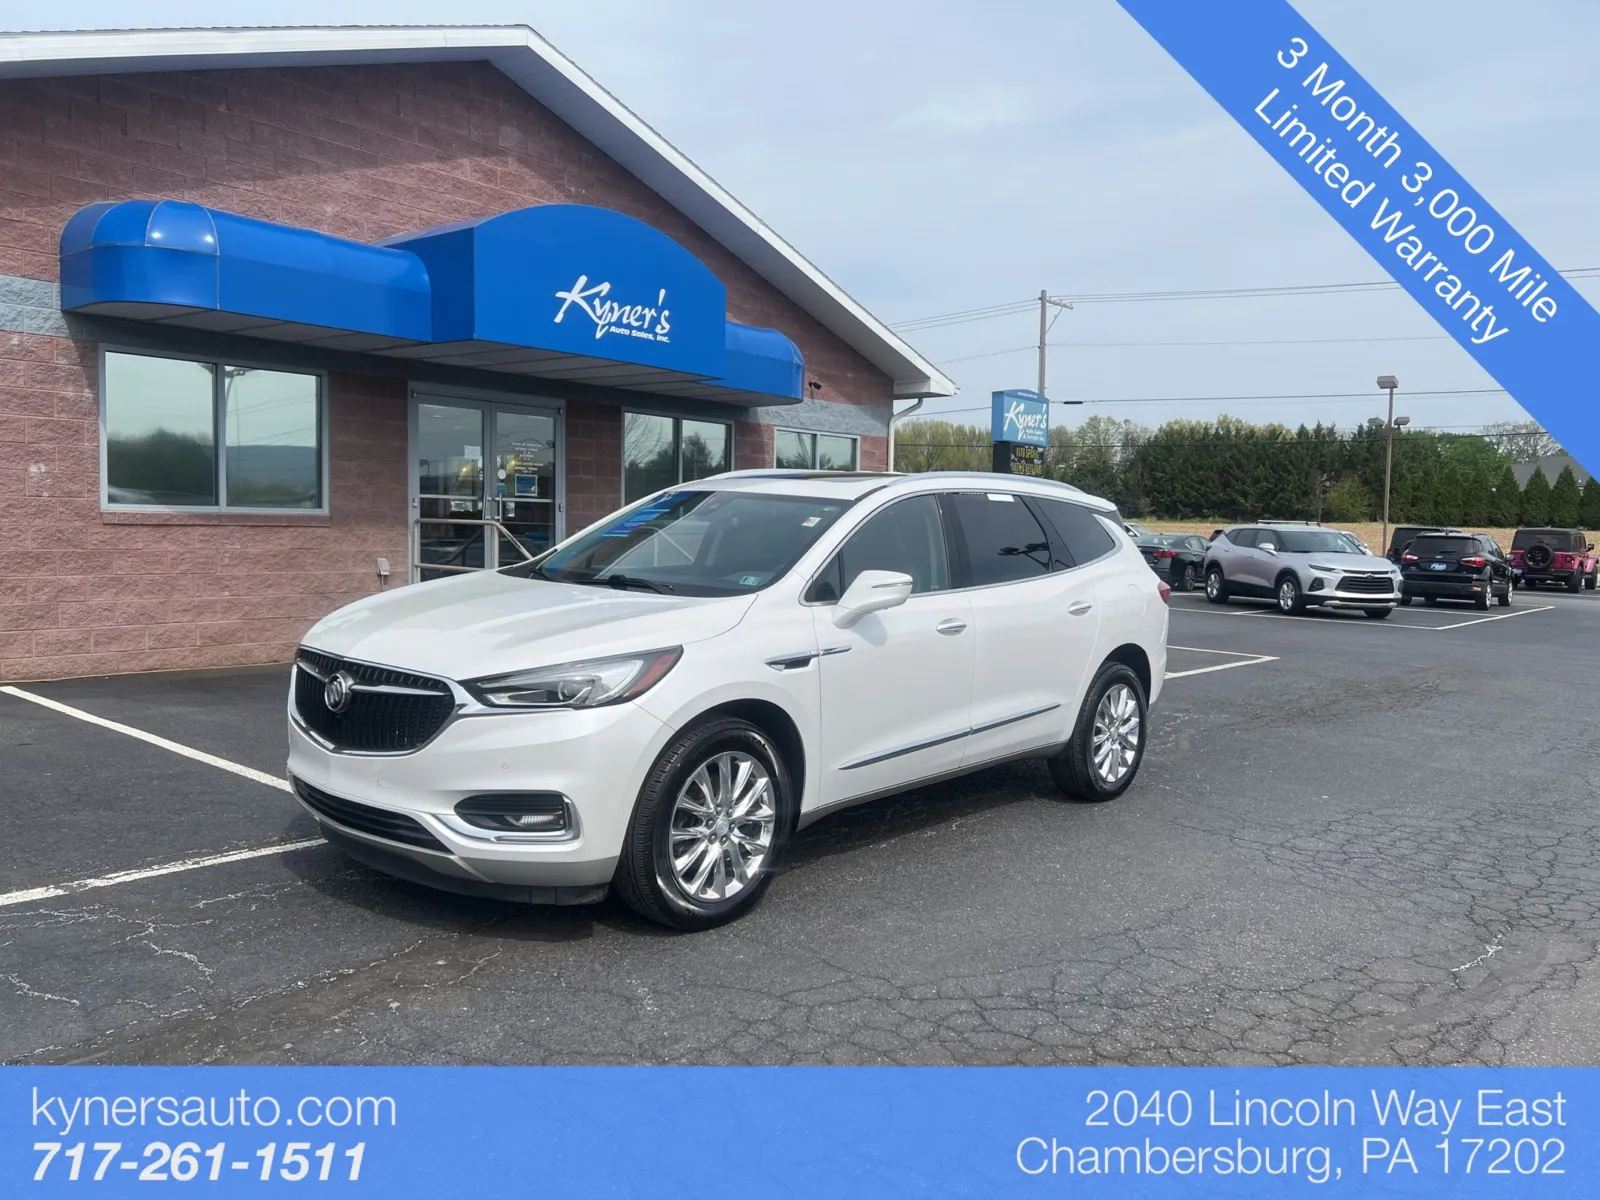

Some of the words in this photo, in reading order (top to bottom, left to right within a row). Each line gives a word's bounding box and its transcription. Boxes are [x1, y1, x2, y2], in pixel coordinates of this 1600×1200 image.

[554, 275, 670, 339] Kyner's
[609, 325, 629, 336] Auto
[631, 330, 655, 341] Sales,
[656, 334, 670, 343] Inc.
[1004, 400, 1047, 441] Kyner's
